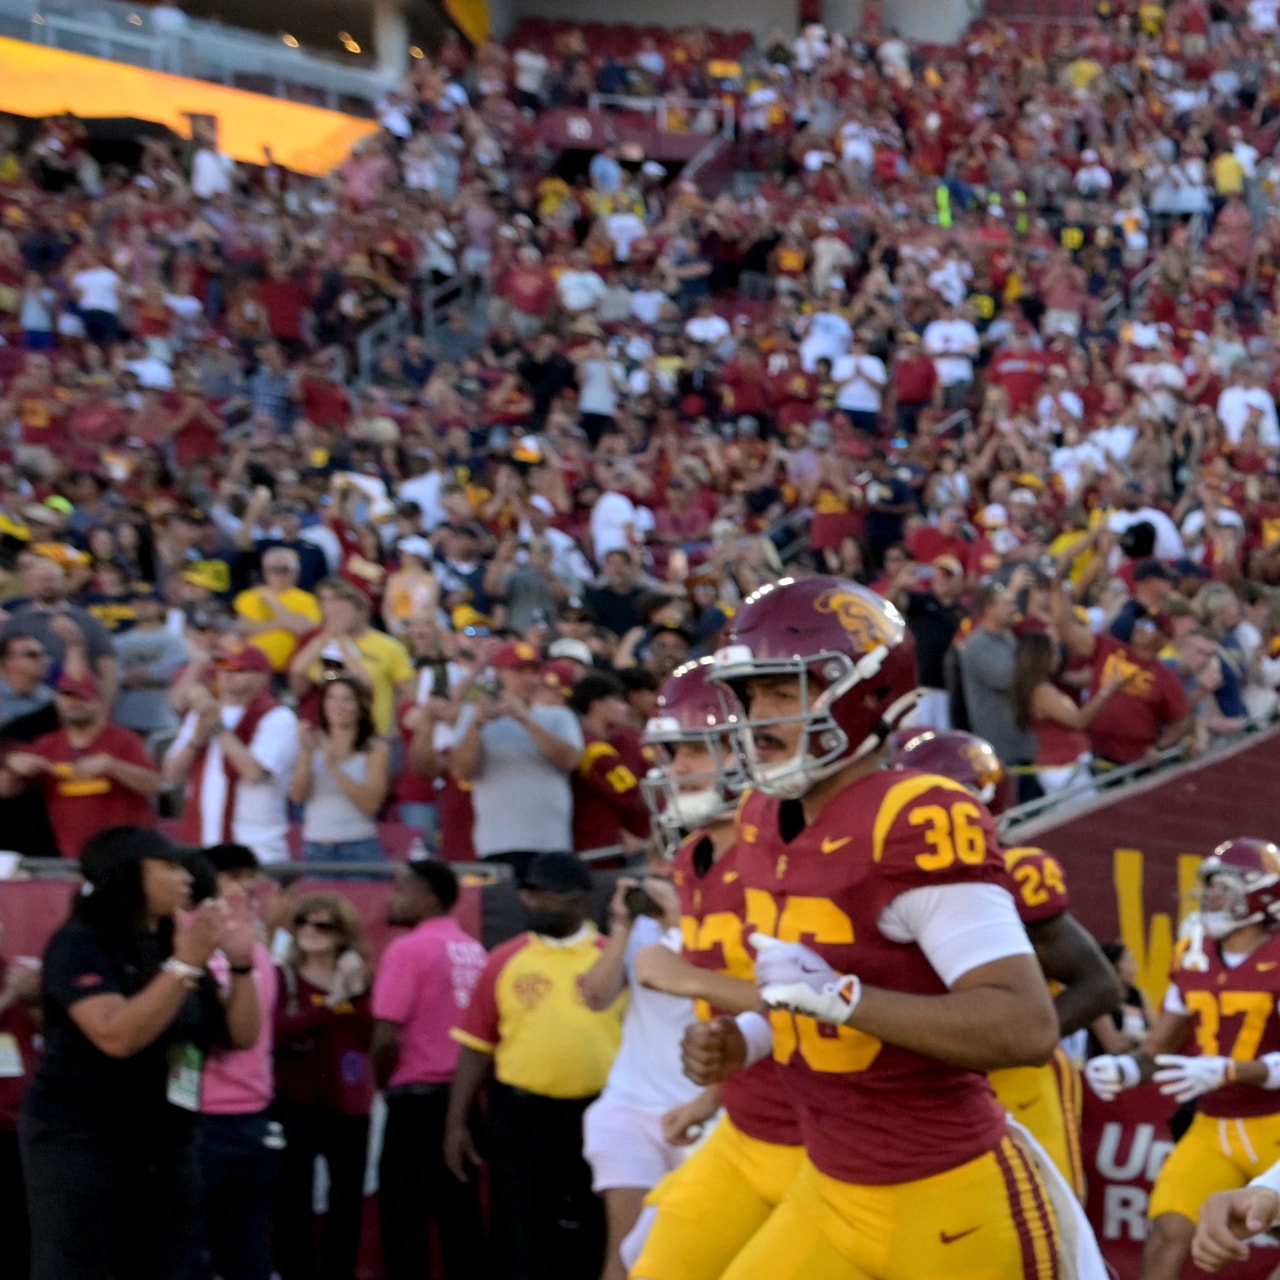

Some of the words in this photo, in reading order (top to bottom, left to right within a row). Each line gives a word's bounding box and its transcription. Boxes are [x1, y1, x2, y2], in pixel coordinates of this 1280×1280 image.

[909, 802, 986, 870] 36
[1012, 857, 1067, 907] 24
[1185, 991, 1273, 1062] 37
